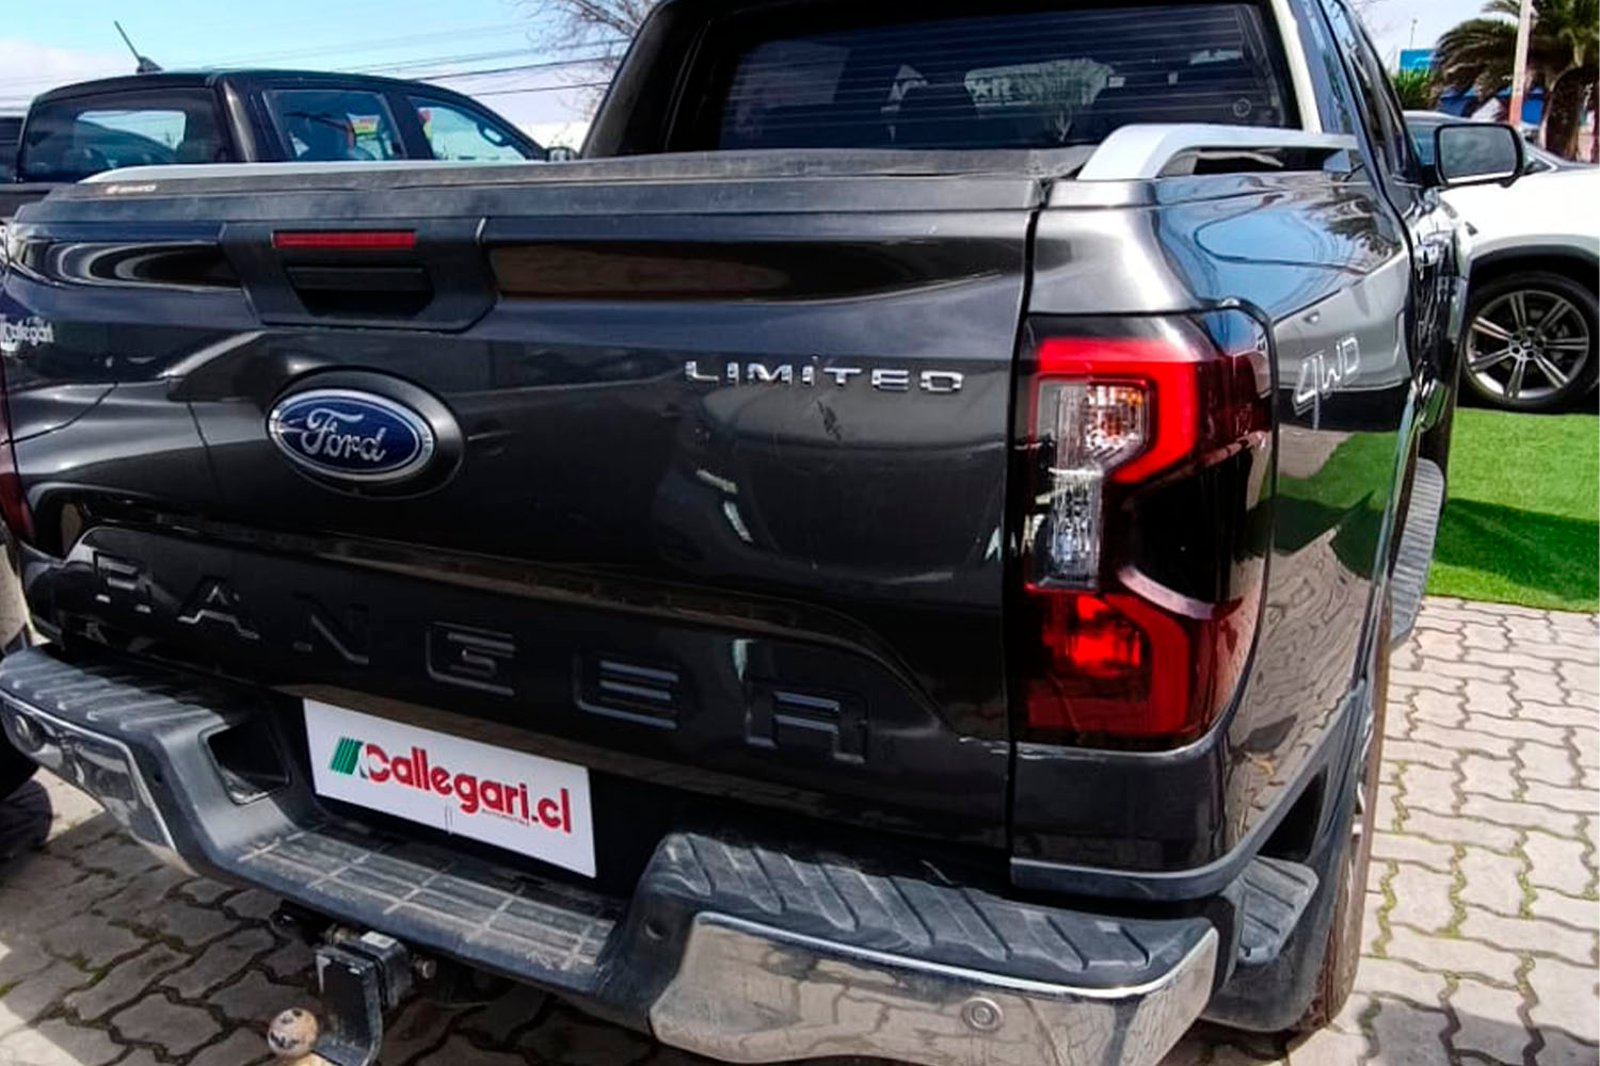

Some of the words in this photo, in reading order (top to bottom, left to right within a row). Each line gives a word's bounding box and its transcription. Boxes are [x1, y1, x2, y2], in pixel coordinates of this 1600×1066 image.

[685, 360, 964, 393] LIMITED
[1293, 337, 1360, 430] 4WD
[301, 407, 388, 462] Ford
[93, 550, 869, 764] RANGER
[366, 743, 572, 833] Callegari.cl
